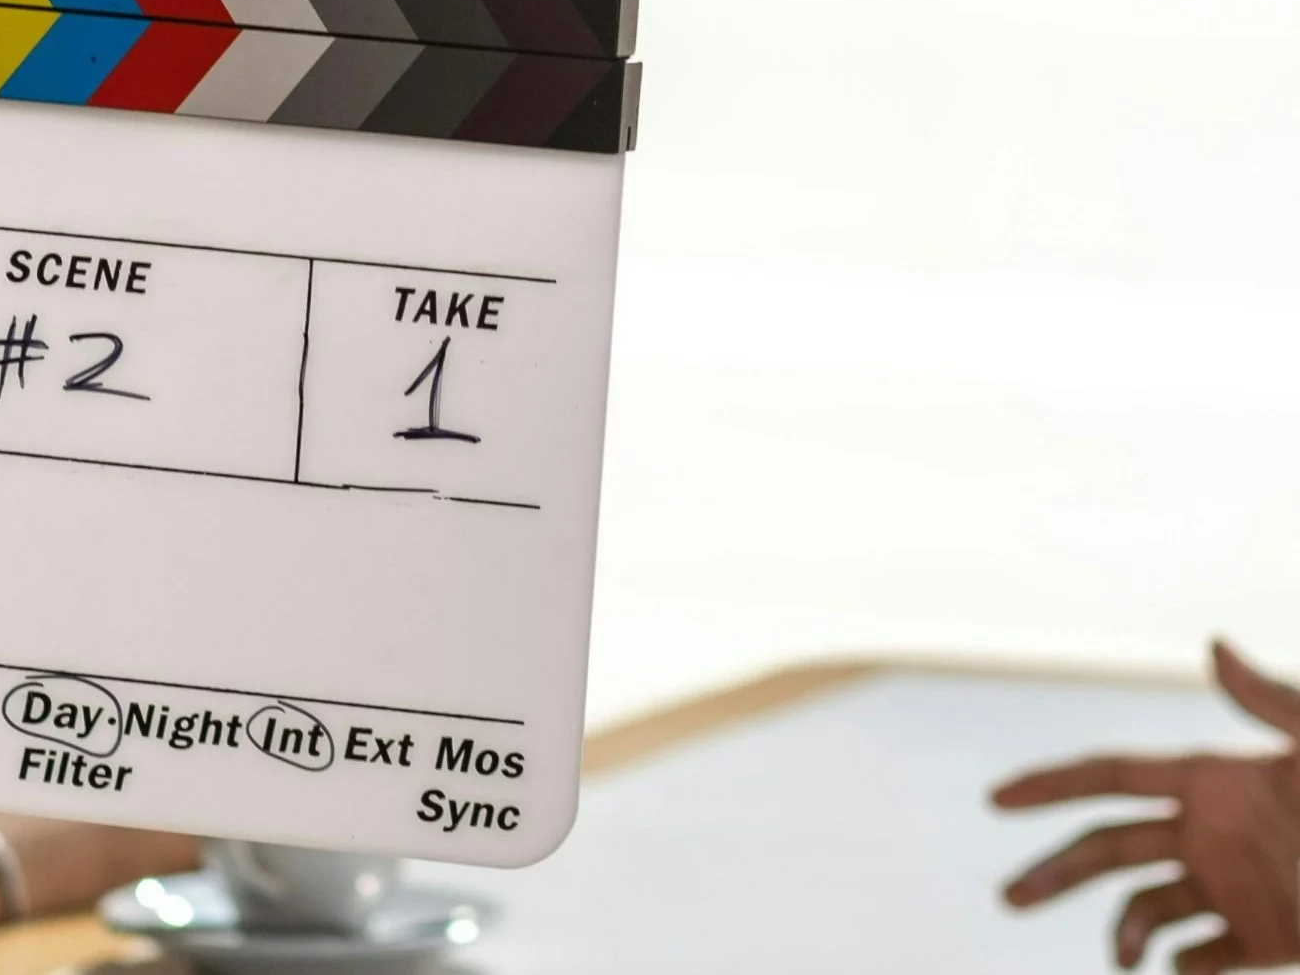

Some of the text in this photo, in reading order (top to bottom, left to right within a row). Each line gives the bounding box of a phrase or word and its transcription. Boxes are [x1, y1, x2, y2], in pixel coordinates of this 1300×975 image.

[5, 249, 152, 295] SCENE
[394, 286, 505, 331] TAKE
[392, 335, 482, 444] 1
[18, 747, 133, 792] Filter
[261, 717, 325, 757] Int
[344, 726, 415, 767] Ext
[434, 736, 525, 779] Mos
[416, 789, 521, 833] Sync
